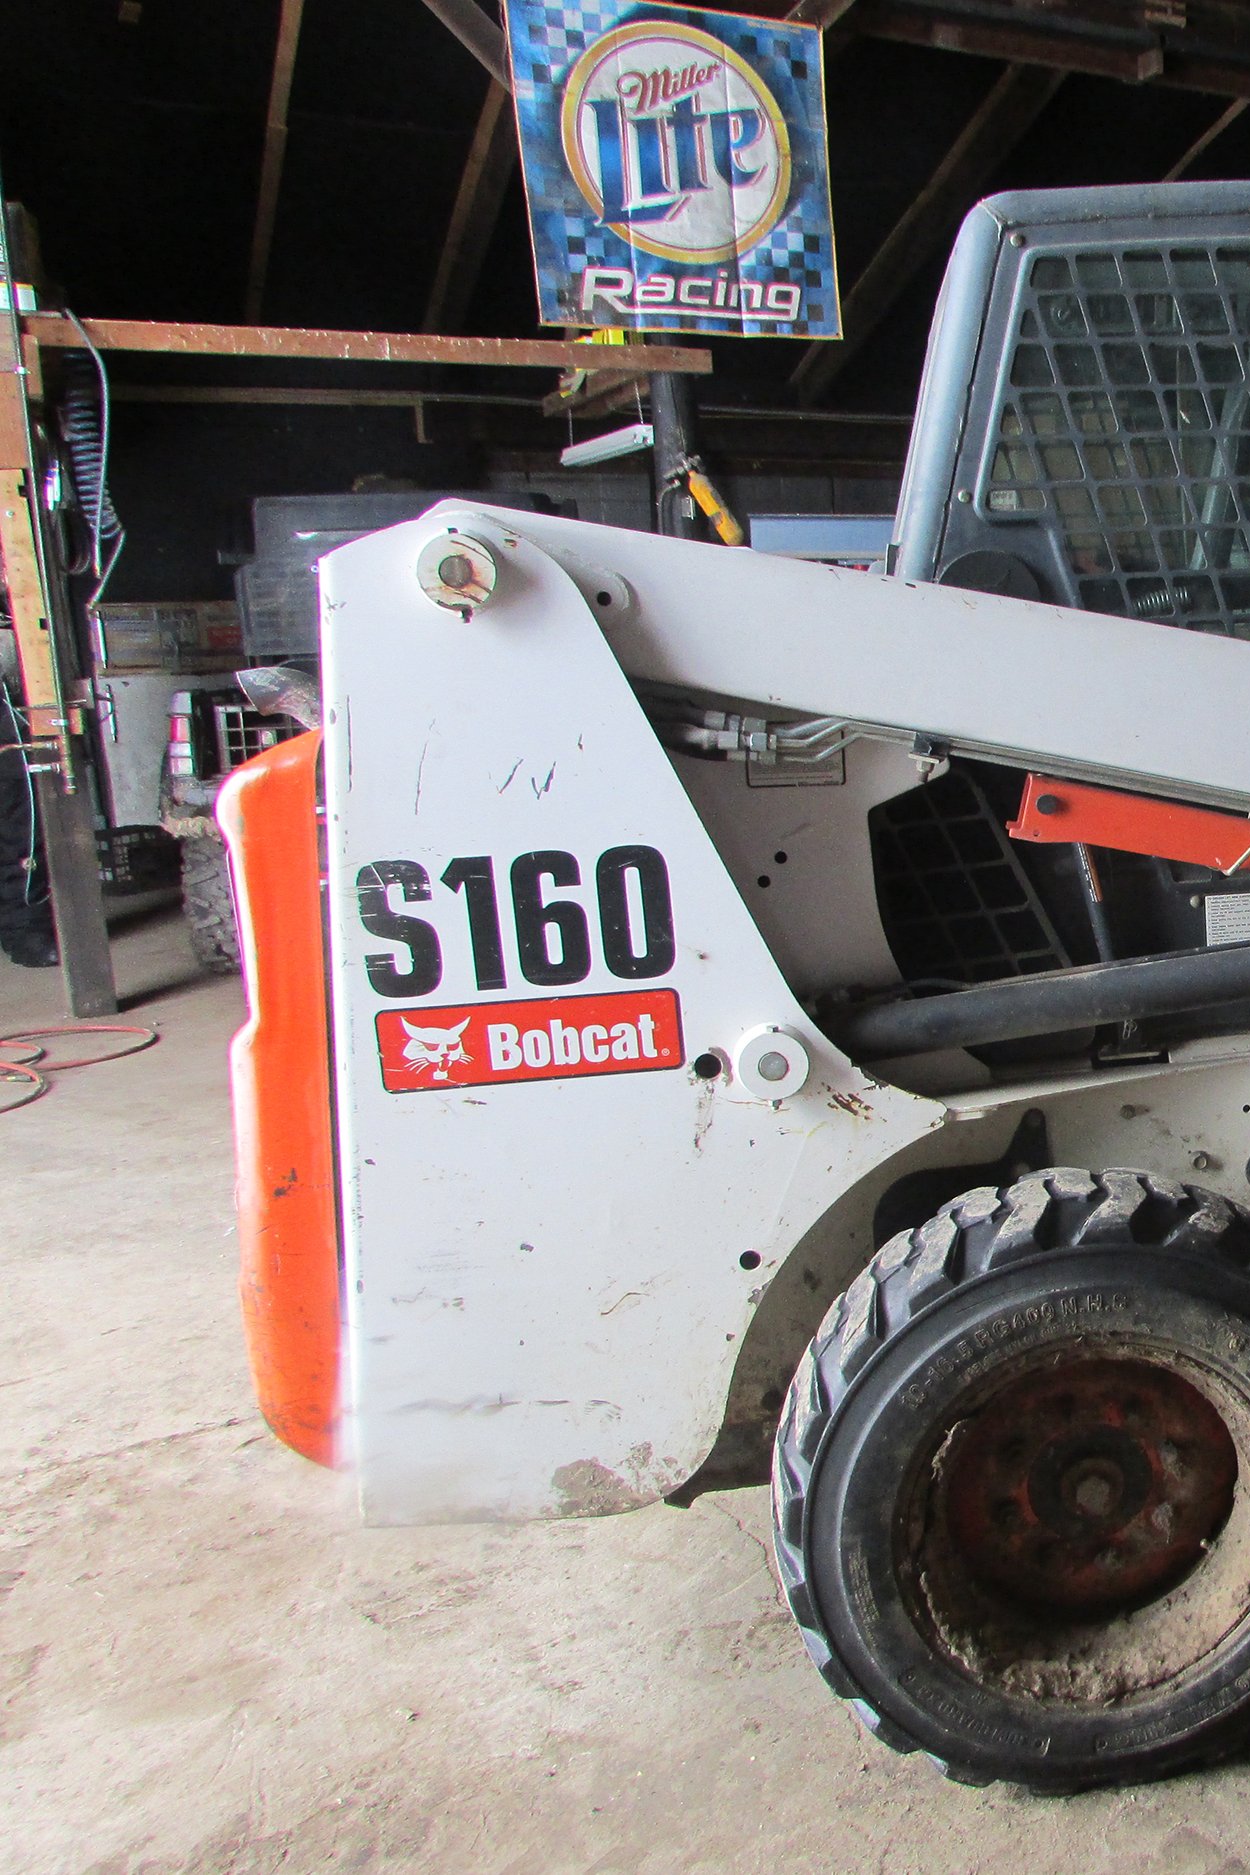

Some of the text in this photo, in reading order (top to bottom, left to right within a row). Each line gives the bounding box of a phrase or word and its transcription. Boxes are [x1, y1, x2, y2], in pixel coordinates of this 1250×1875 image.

[617, 61, 723, 116] Miller
[584, 94, 770, 226] Lite
[582, 266, 801, 321] Racing
[355, 844, 676, 999] S160
[487, 1013, 659, 1071] Bobcat
